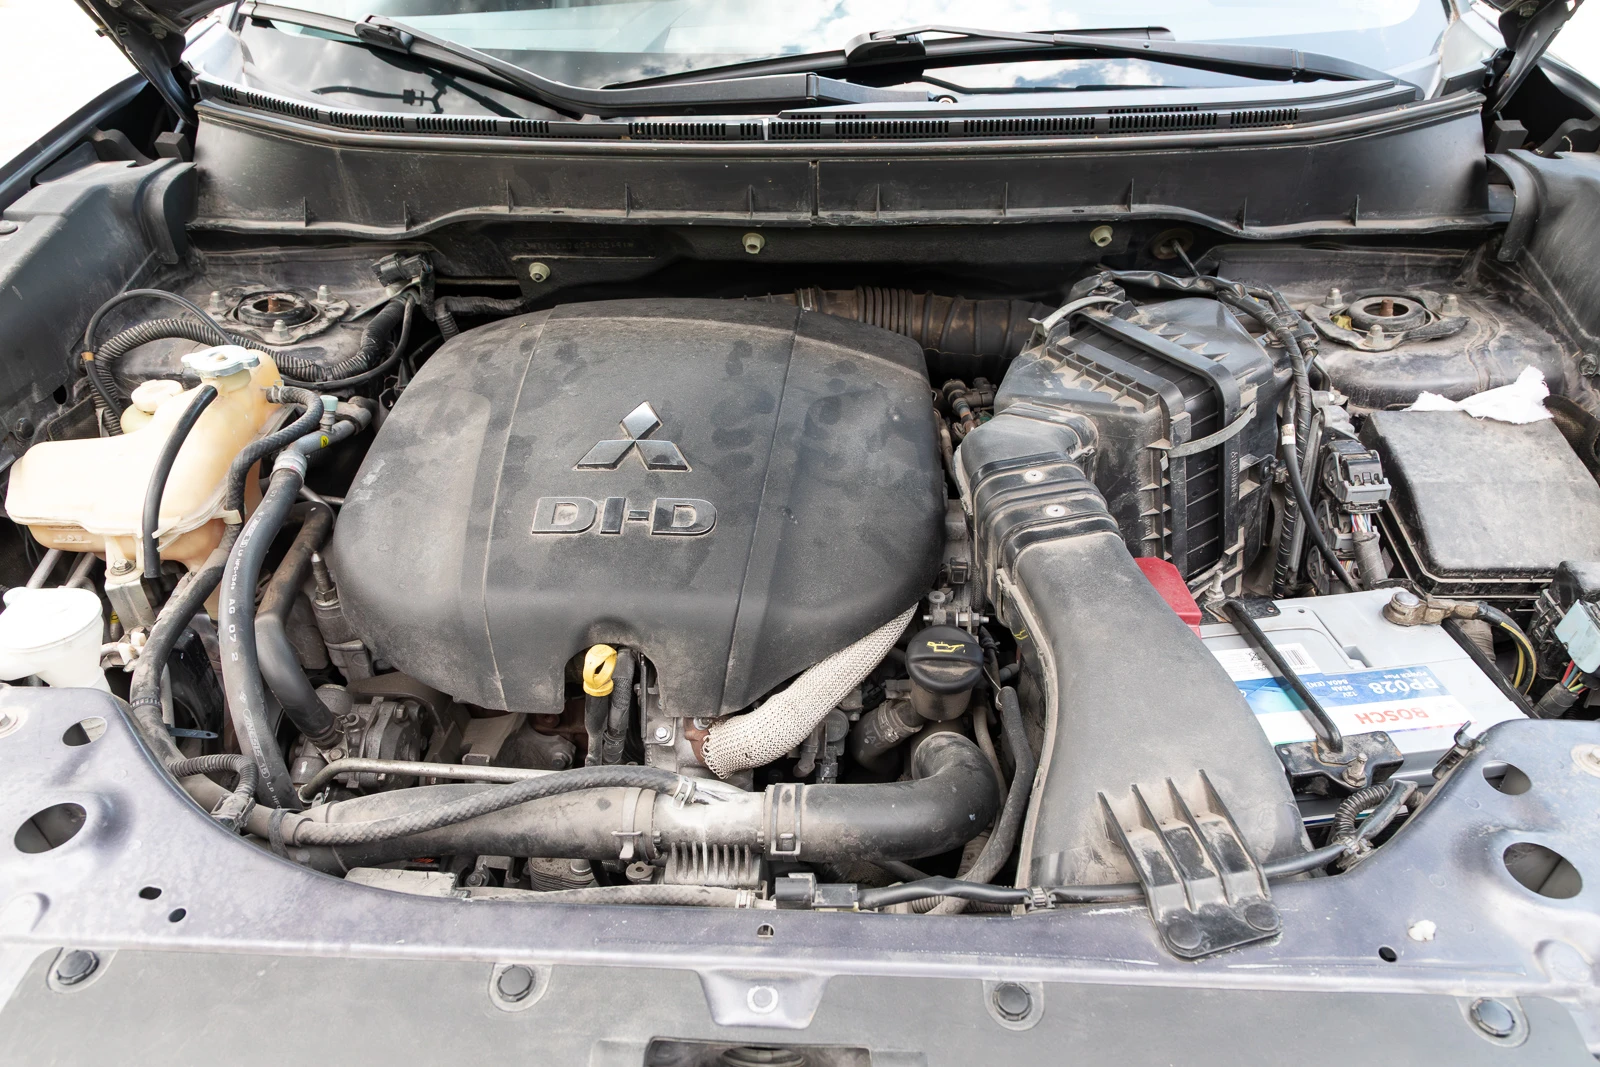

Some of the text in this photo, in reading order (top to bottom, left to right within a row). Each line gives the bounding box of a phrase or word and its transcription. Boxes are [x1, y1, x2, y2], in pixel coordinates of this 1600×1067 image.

[531, 496, 718, 536] DI-D
[228, 598, 236, 615] AG
[228, 624, 237, 643] 07
[231, 652, 238, 662] 2
[1342, 690, 1358, 698] 12V
[1368, 677, 1439, 694] PP028
[1354, 707, 1429, 725] BOSCH
[272, 794, 281, 809] HFC
